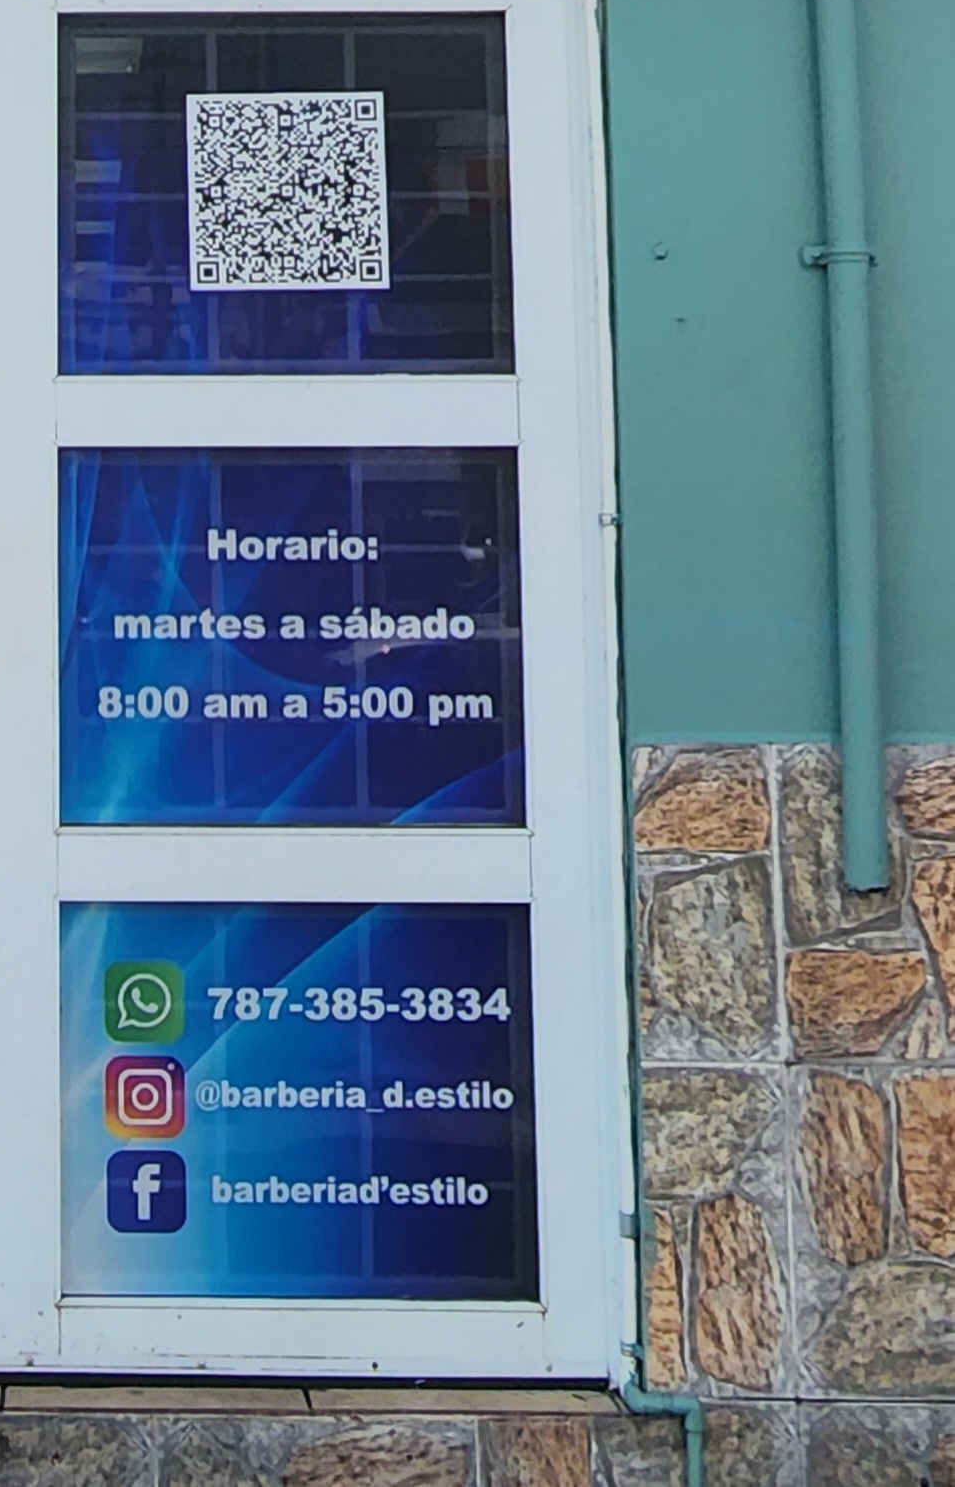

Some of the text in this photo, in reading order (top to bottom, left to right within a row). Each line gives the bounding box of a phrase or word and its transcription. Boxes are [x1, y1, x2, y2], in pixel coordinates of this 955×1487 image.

[207, 528, 379, 561] Horario:
[114, 607, 476, 640] martes a sábado
[97, 686, 493, 726] 8:00 am a 5:00 pm
[207, 987, 512, 1021] 787-385-3834
[195, 1080, 514, 1113] @barberia_d.estilo
